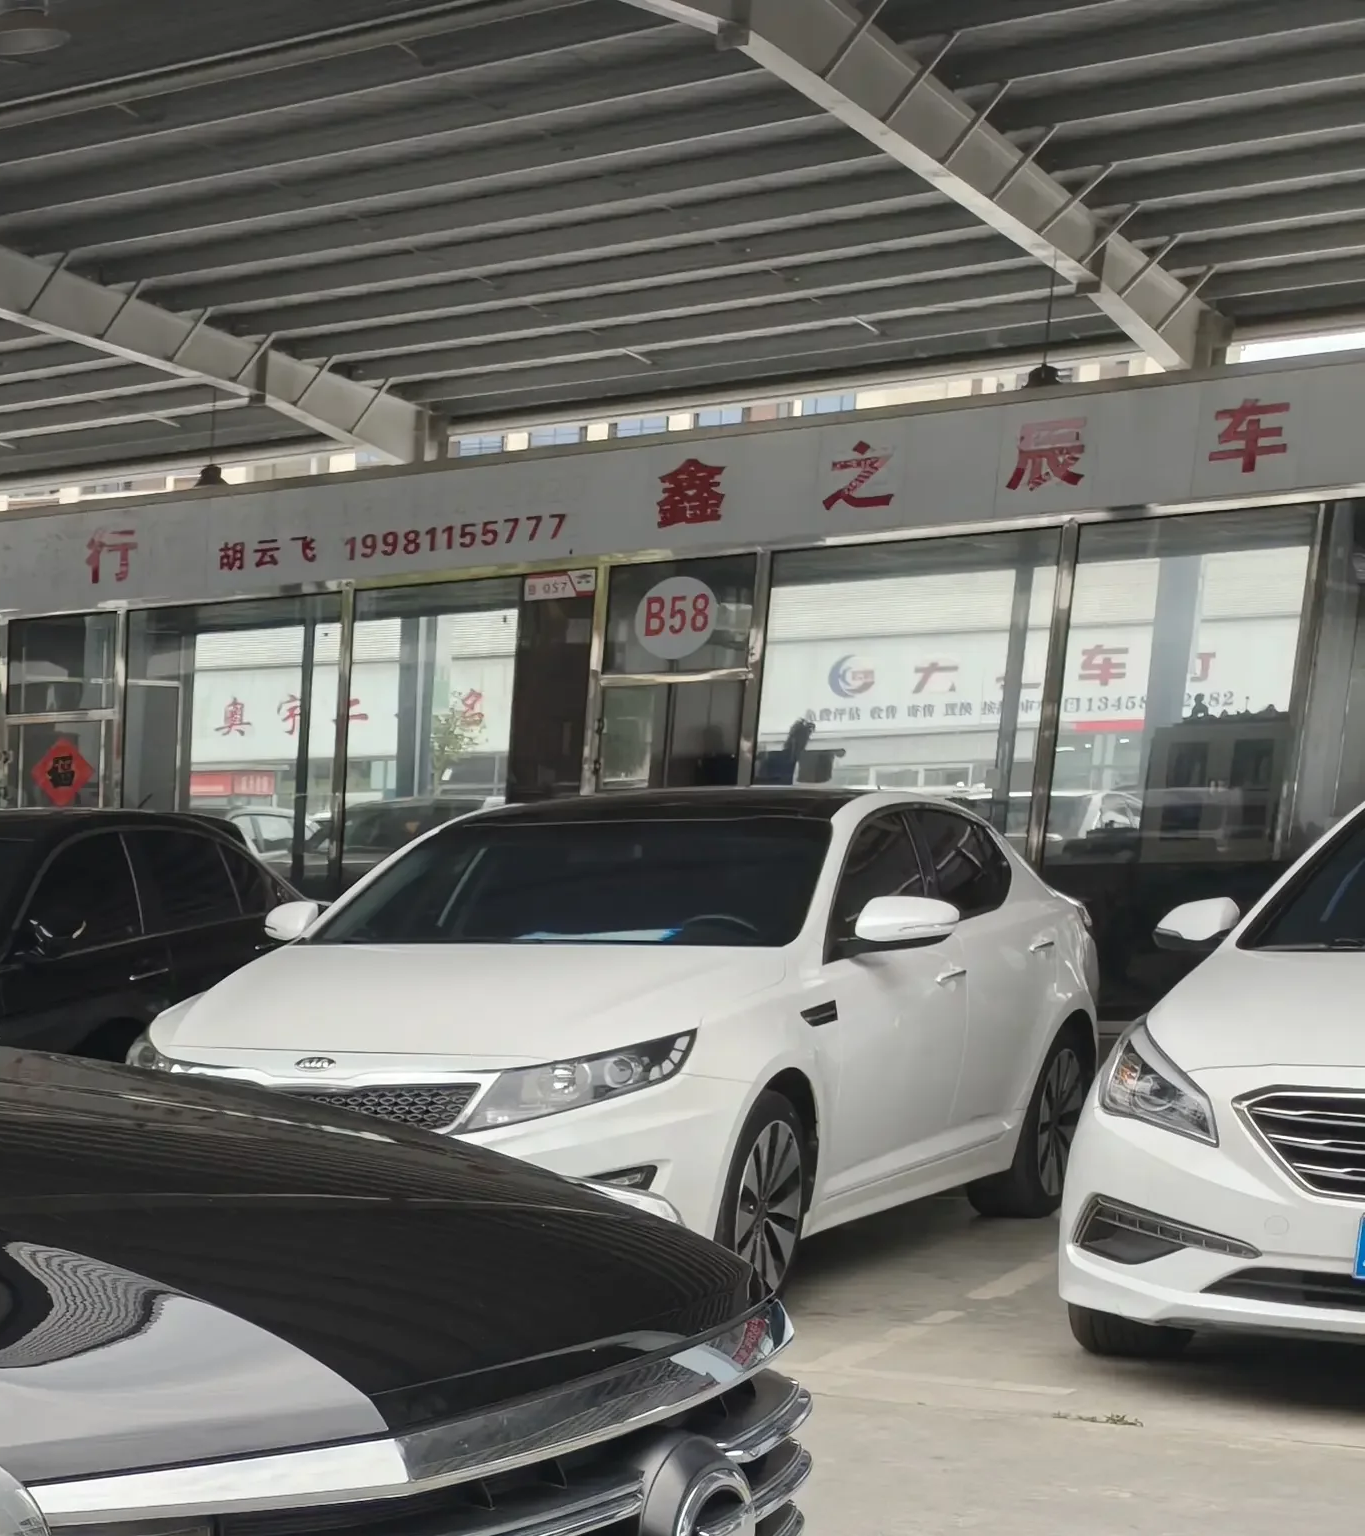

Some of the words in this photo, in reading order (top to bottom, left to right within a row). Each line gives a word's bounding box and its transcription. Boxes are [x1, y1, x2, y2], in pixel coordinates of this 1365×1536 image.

[656, 397, 1291, 529] 鑫之辰车
[218, 535, 318, 571] 胡云飞
[343, 512, 568, 561] 19981155777
[644, 591, 710, 638] B58
